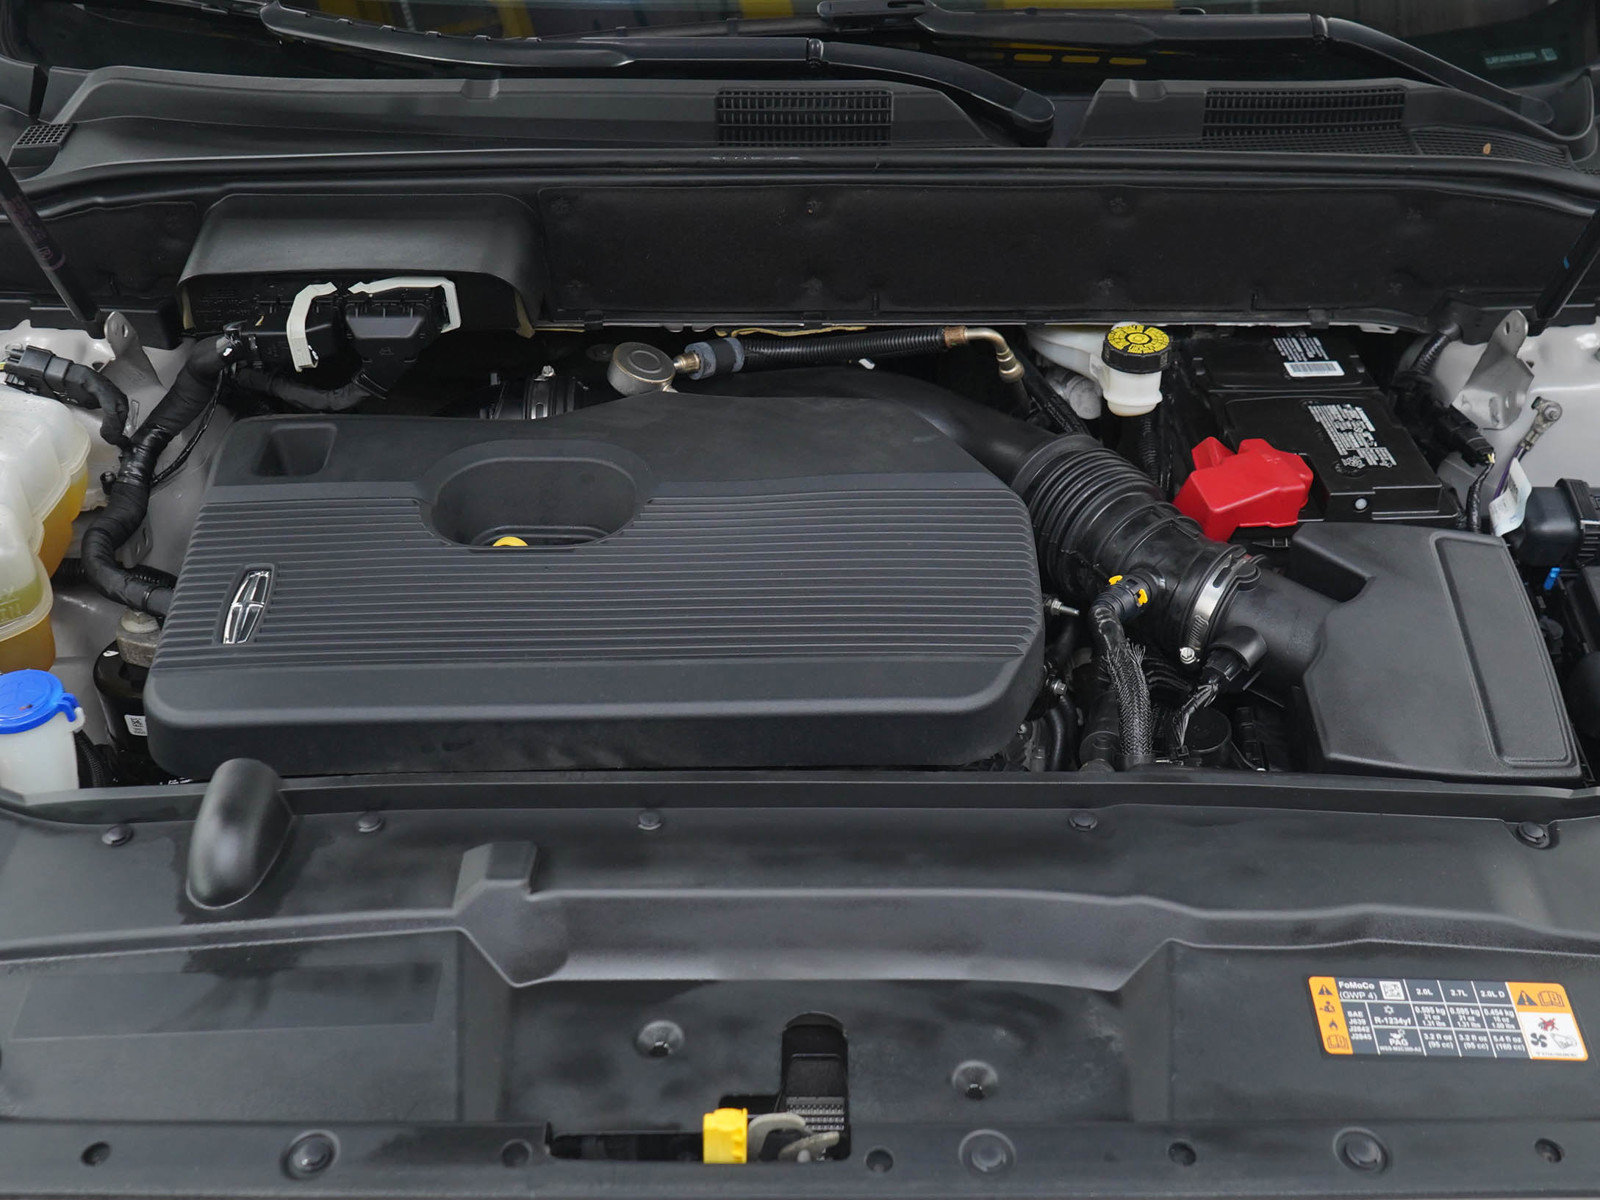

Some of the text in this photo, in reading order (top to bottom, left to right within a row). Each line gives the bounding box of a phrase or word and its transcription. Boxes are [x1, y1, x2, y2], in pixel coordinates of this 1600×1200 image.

[1339, 981, 1375, 990] FoMoCo
[1340, 991, 1378, 1001] (GWP 4)
[1416, 988, 1434, 996] 2.0L
[1450, 989, 1468, 997] 2.7L
[1480, 990, 1498, 998] 2.0L
[1436, 1007, 1446, 1016] kg
[1470, 1008, 1480, 1017] kg
[1504, 1009, 1515, 1018] kg
[1374, 1017, 1411, 1026] R-1234yf
[1389, 1038, 1409, 1046] PAG
